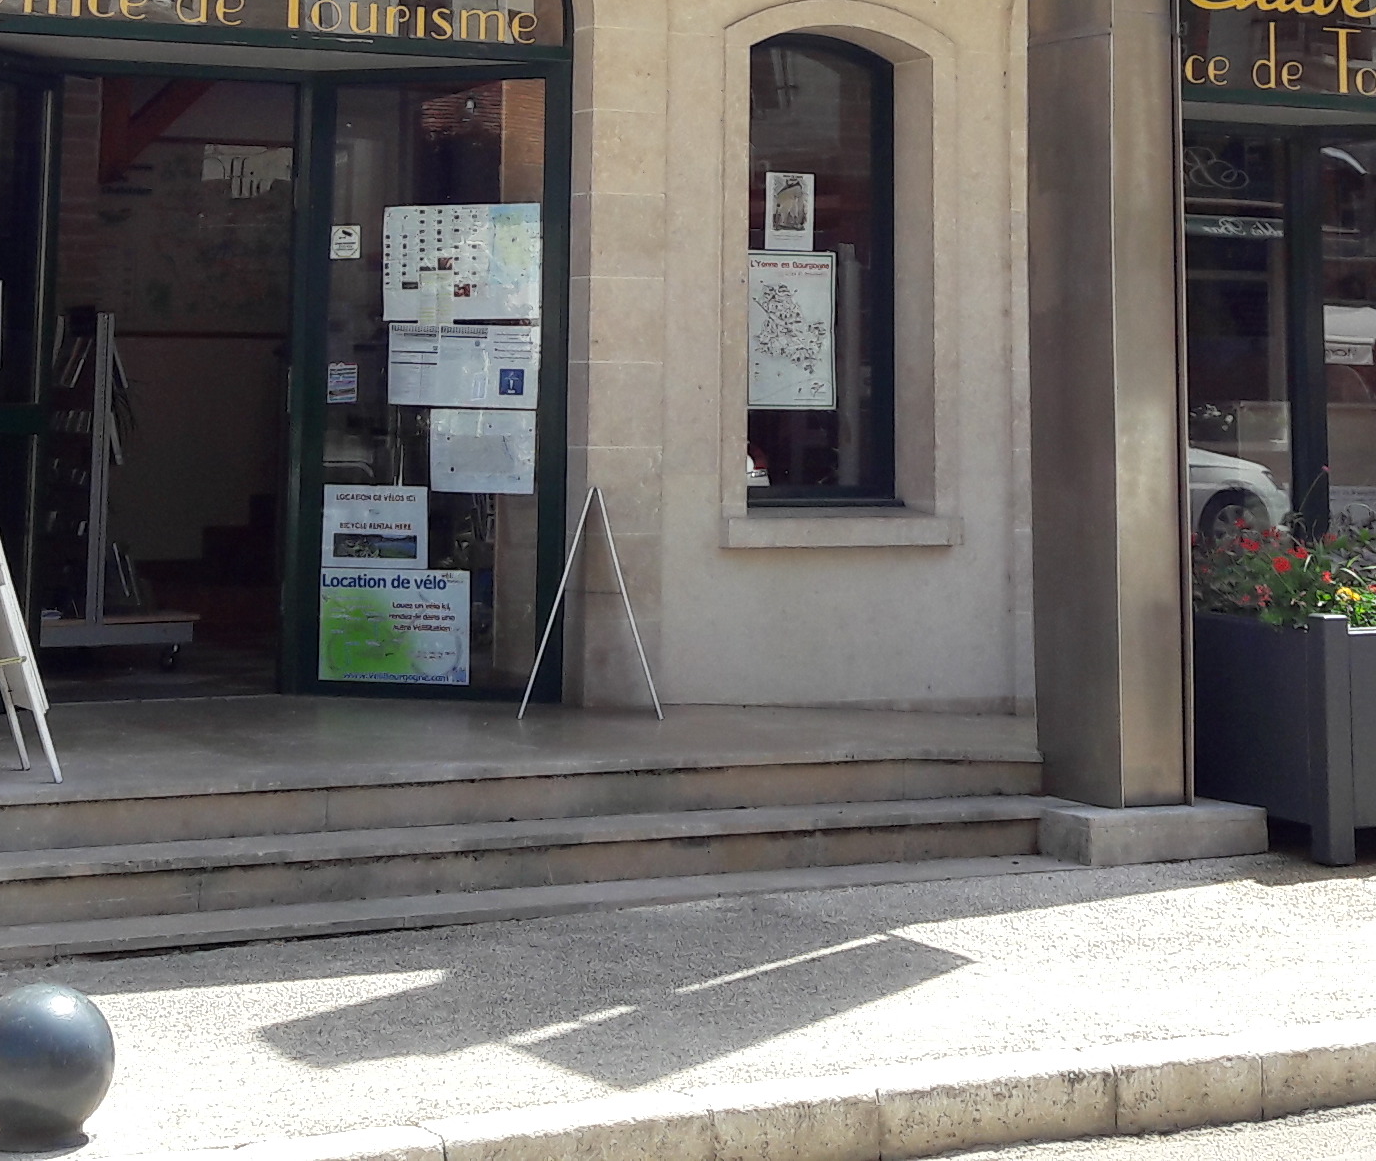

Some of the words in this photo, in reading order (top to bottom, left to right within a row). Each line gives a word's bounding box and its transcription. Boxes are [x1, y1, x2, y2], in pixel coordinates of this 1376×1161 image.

[1252, 21, 1304, 91] de
[792, 261, 830, 271] Bourgogne
[336, 493, 372, 501] LOCATION
[322, 574, 387, 588] Location
[391, 574, 411, 589] de
[414, 574, 447, 590] vélo
